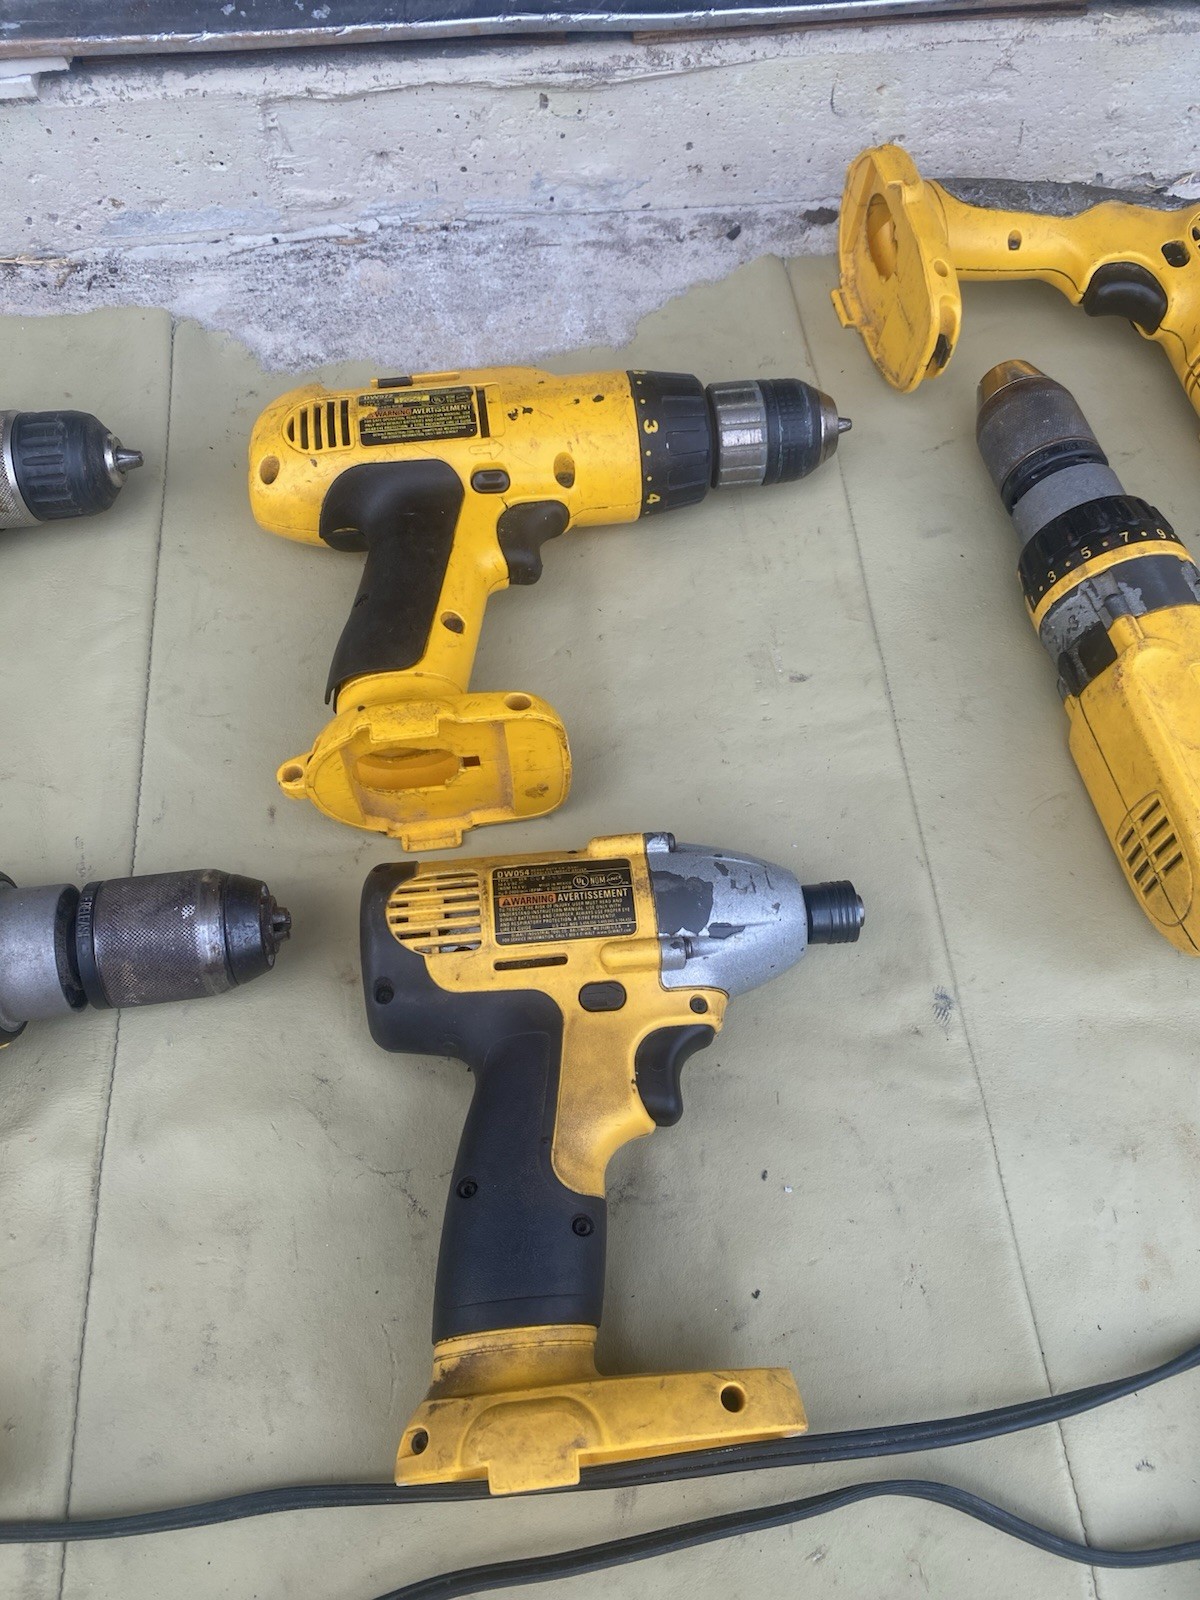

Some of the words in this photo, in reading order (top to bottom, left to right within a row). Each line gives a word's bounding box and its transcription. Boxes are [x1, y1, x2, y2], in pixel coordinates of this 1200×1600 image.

[375, 408, 411, 418] WARNING
[643, 418, 659, 434] 3
[646, 494, 661, 504] 4
[1047, 570, 1056, 583] 3
[1080, 546, 1092, 560] 5
[1119, 531, 1130, 542] 7
[1156, 528, 1167, 540] 9
[497, 869, 530, 878] DW054
[511, 894, 554, 906] WARNING
[557, 888, 628, 902] AVERTISSEMENT
